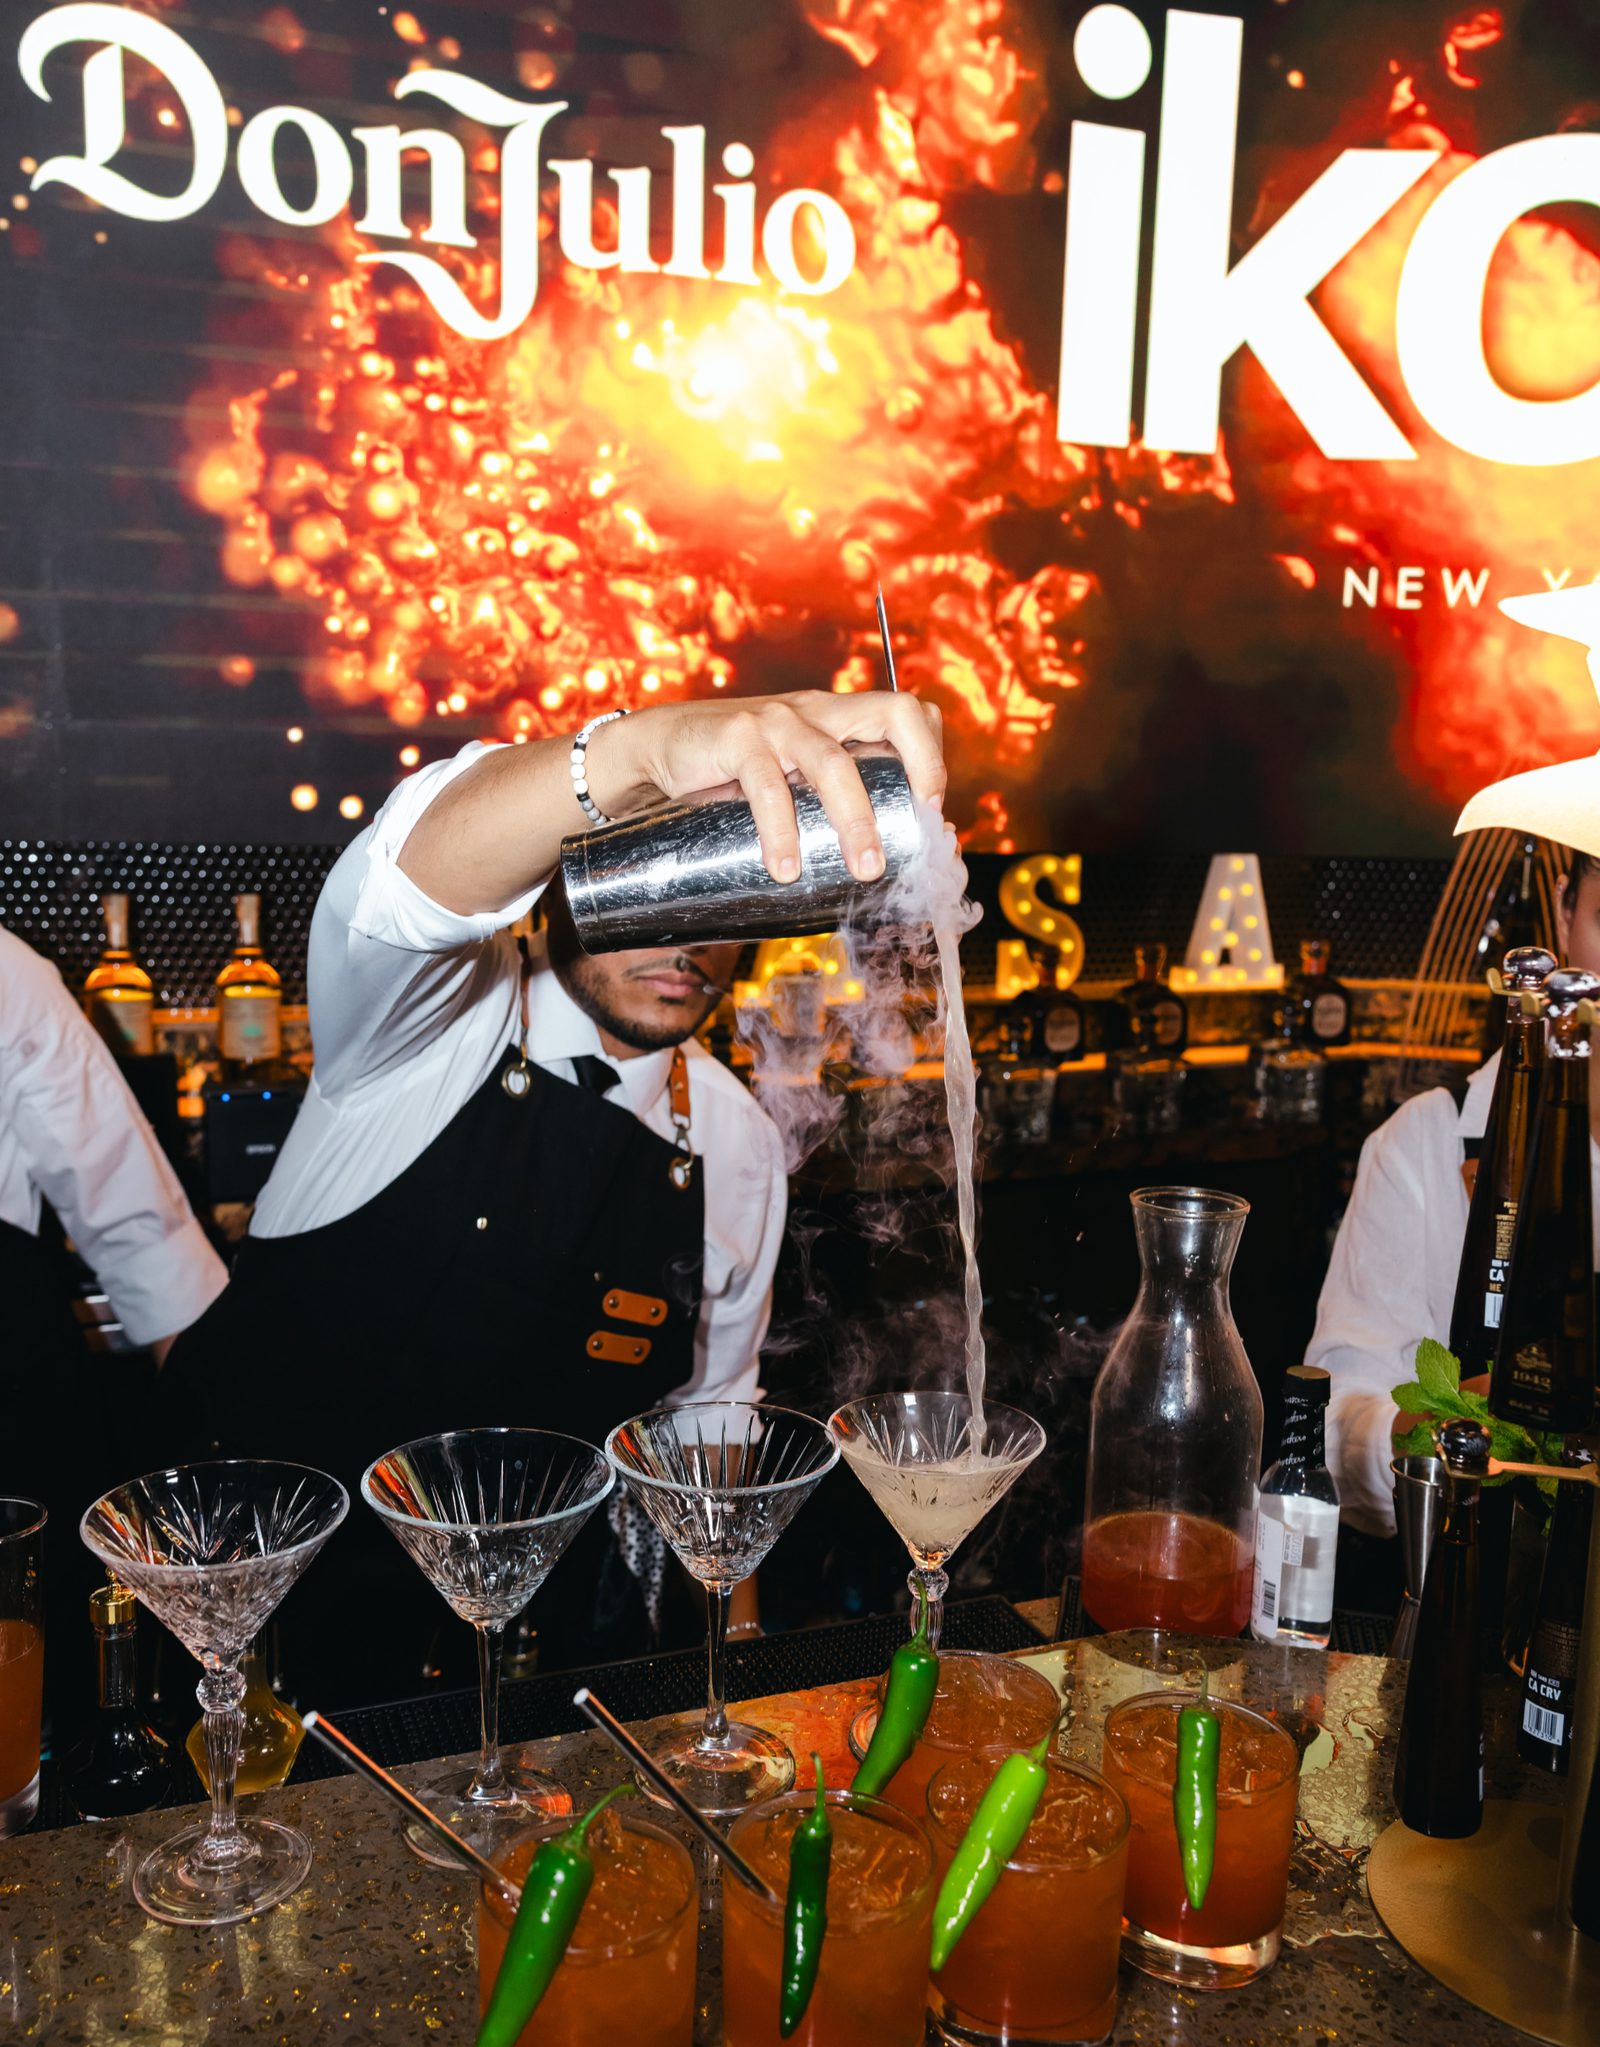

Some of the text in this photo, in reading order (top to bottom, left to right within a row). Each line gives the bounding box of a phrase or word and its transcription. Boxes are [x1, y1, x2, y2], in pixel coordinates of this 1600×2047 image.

[1342, 566, 1490, 609] NEW
[1528, 1676, 1538, 1693] CA
[1540, 1684, 1561, 1701] CRV
